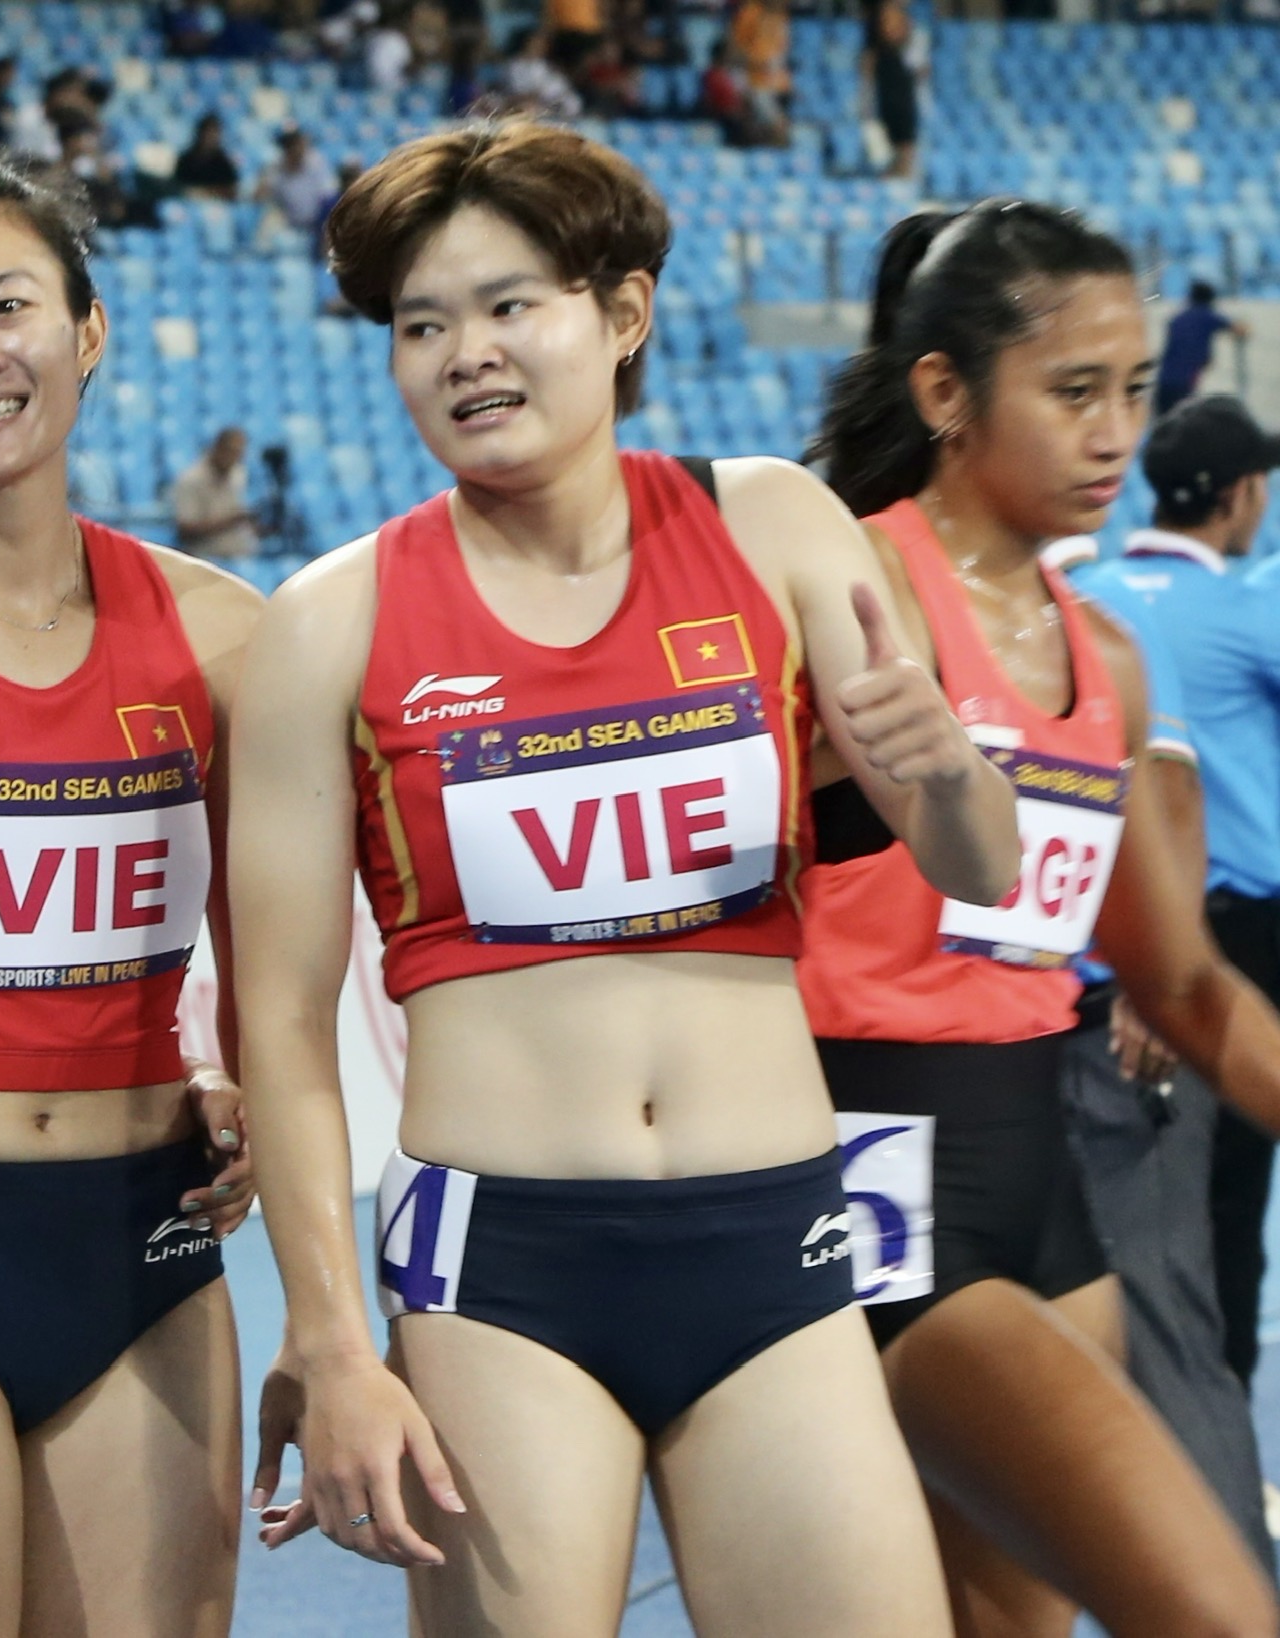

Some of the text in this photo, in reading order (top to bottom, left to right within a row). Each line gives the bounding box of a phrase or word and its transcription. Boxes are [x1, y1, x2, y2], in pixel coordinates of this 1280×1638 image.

[403, 697, 506, 725] LI-NING
[517, 703, 738, 759] 32nd SEA GAMES
[63, 777, 112, 800] SEA
[117, 768, 183, 797] GAMES
[511, 777, 733, 892] VIE
[94, 965, 109, 984] IN
[112, 960, 148, 981] PEACE
[145, 1238, 219, 1263] LI-NIN
[380, 1164, 448, 1312] 4
